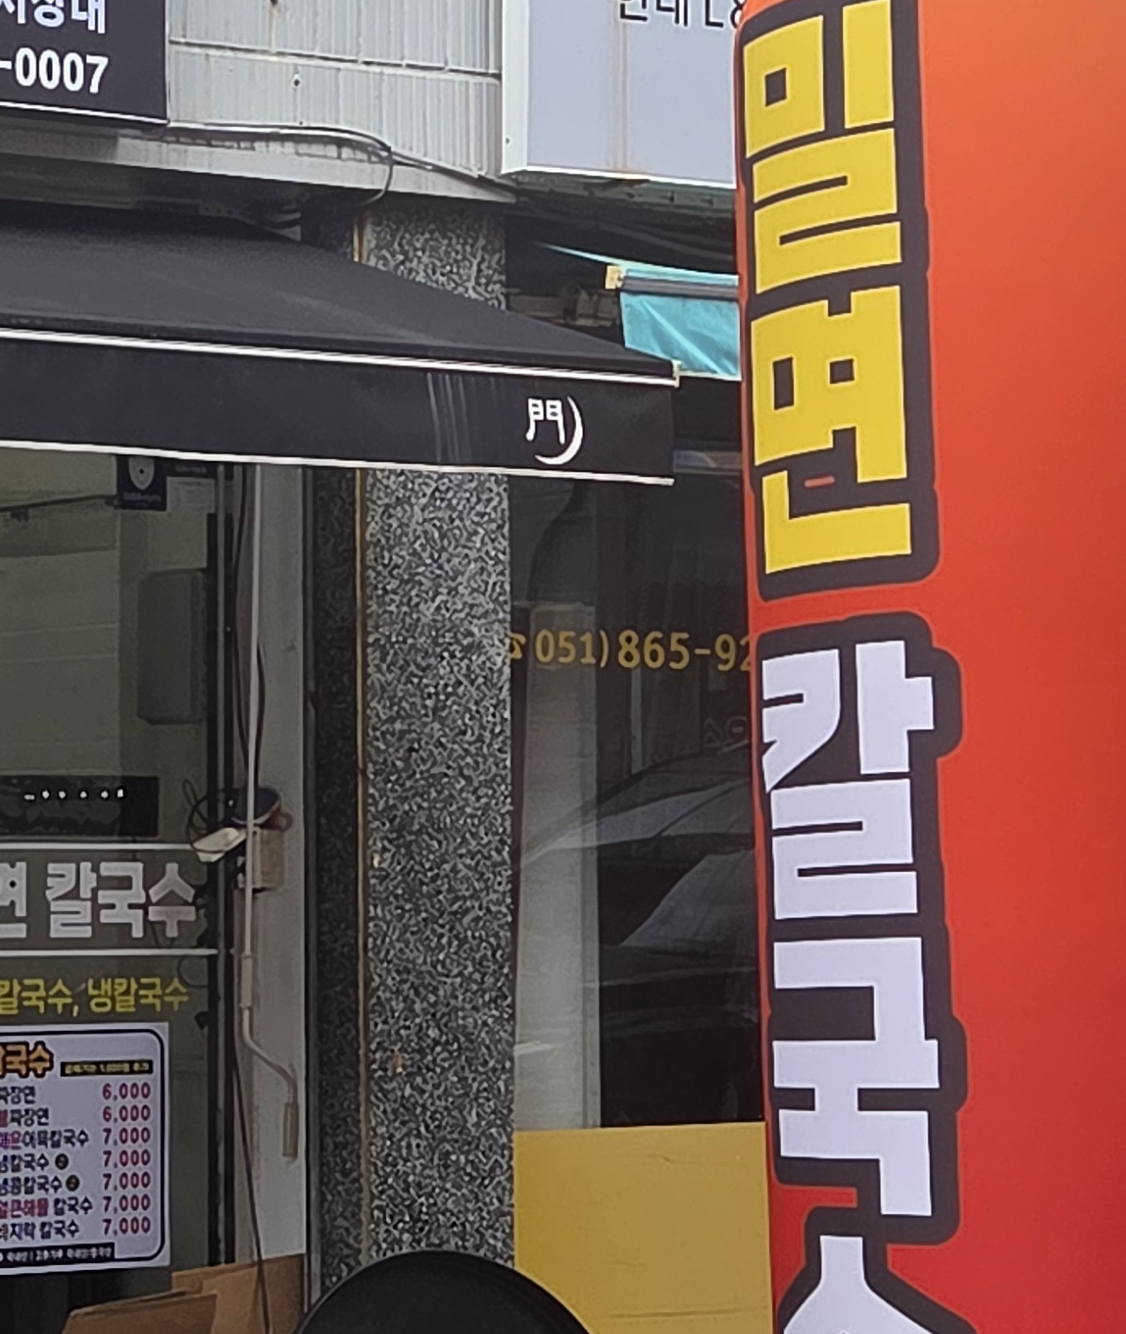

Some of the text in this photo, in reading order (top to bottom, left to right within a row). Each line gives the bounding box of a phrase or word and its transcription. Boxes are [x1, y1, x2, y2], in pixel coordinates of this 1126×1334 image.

[45, 861, 196, 939] 칼국수
[88, 977, 189, 1013] 냉칼국수
[102, 1082, 151, 1101] 6,000
[102, 1104, 151, 1123] 6,000
[102, 1127, 151, 1146] 7,000
[102, 1149, 151, 1168] 7,000
[102, 1171, 151, 1191] 7,000
[53, 1196, 93, 1216] 칼국수
[102, 1194, 151, 1214] 7,000
[40, 1219, 80, 1240] 칼국수
[102, 1216, 151, 1237] 7,000
